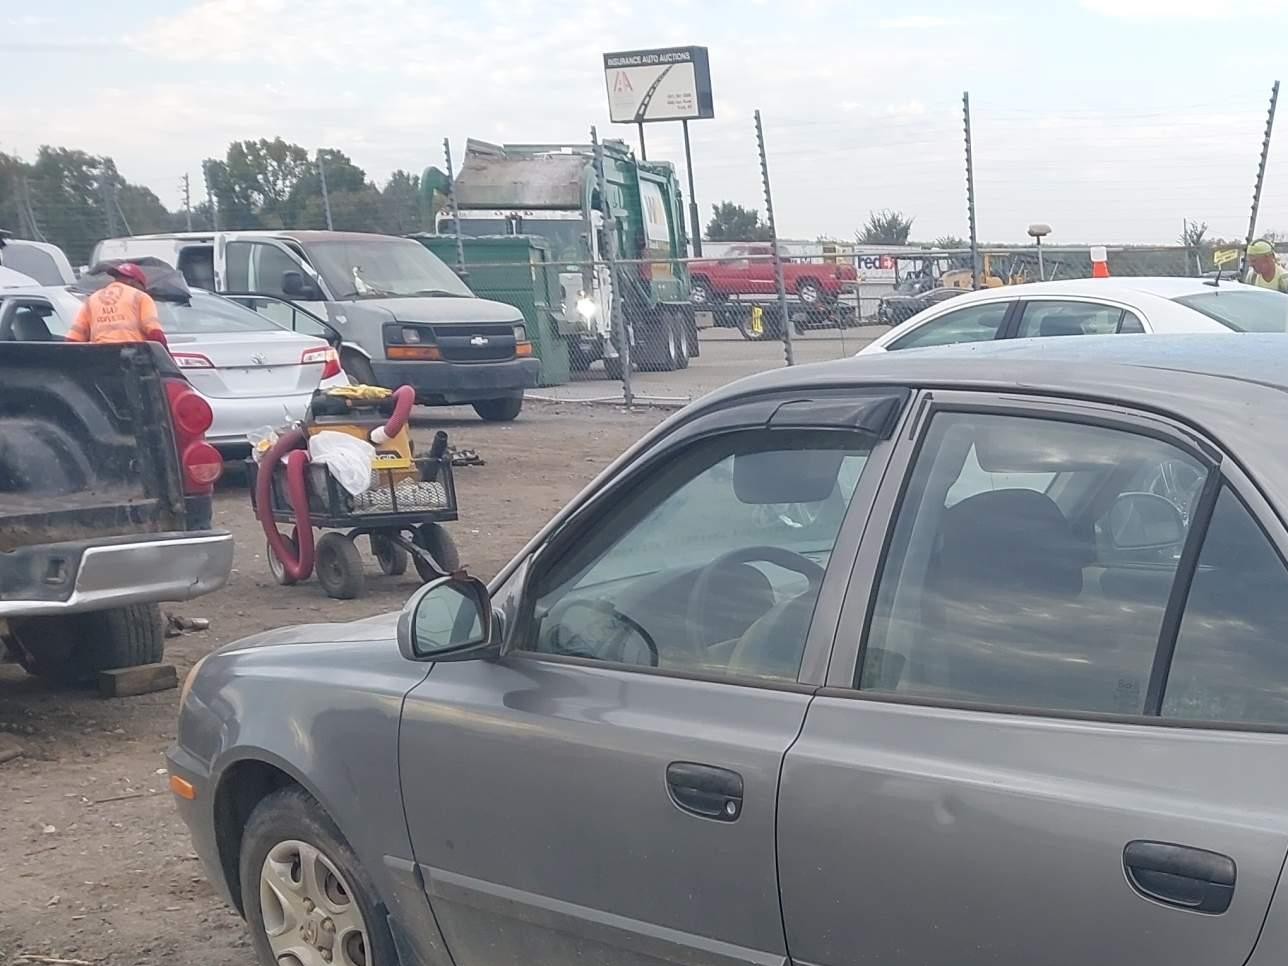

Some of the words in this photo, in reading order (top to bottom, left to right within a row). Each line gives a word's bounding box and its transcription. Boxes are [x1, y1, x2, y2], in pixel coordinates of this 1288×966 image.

[607, 56, 641, 66] INSURANCE
[642, 54, 659, 64] AUTO
[659, 51, 691, 62] AUCTIONS
